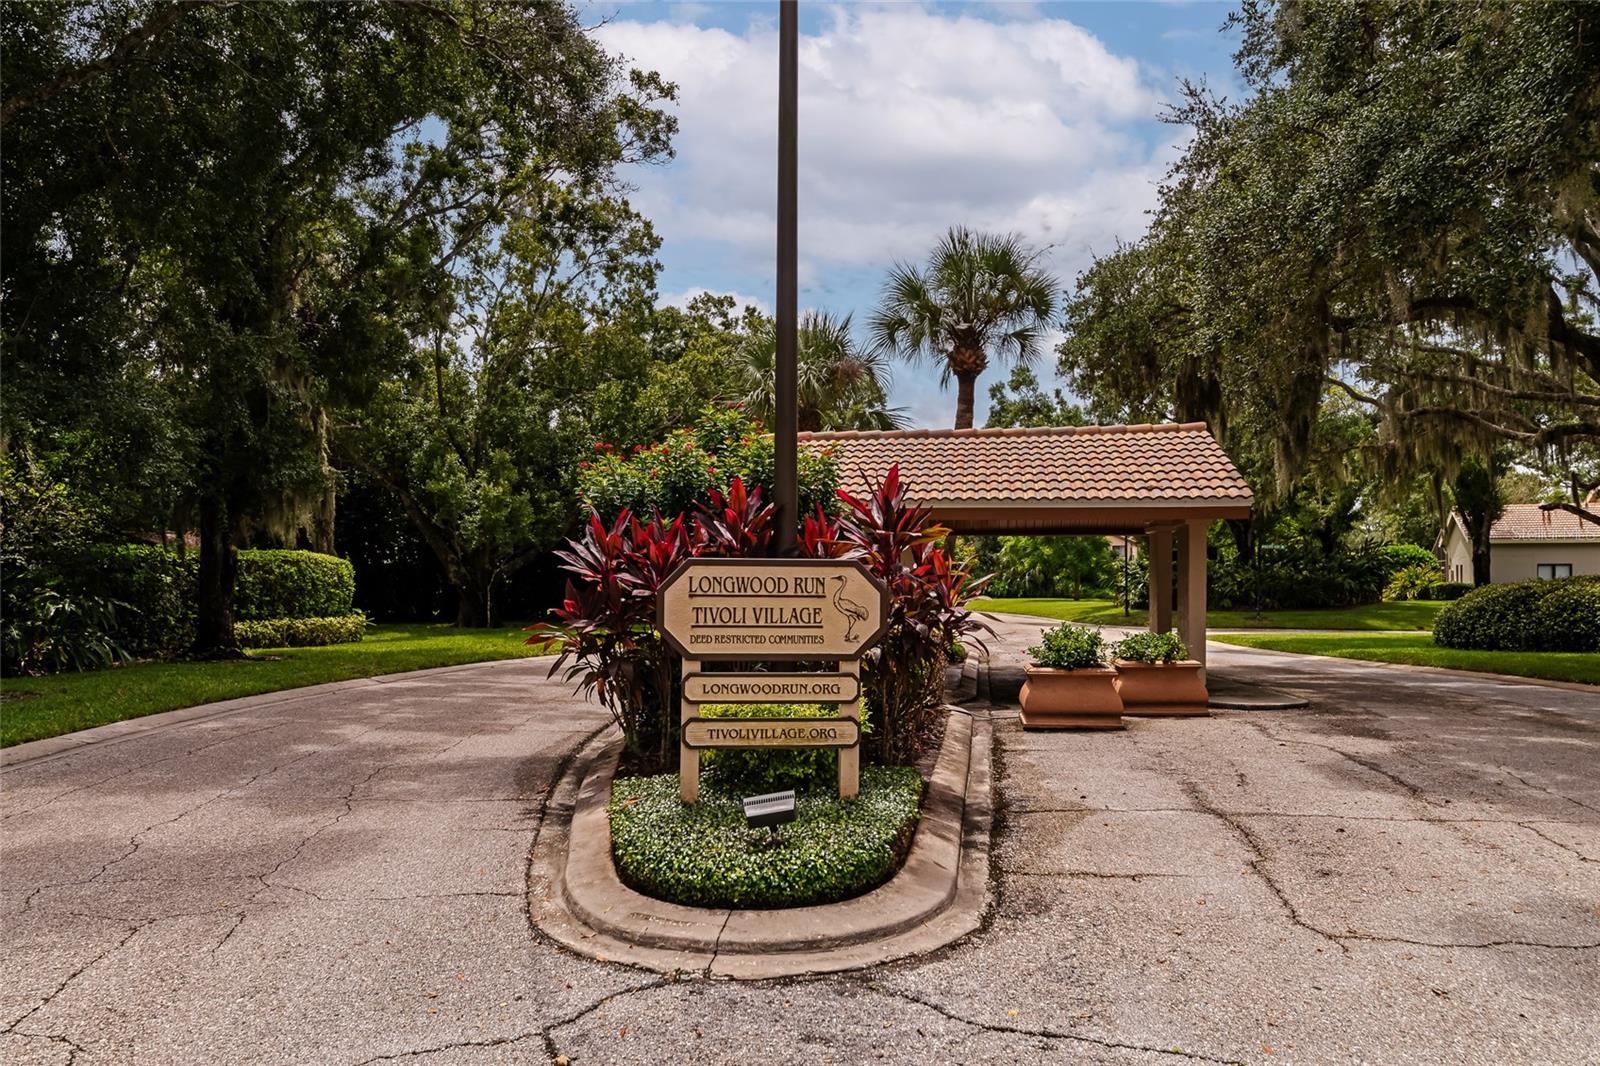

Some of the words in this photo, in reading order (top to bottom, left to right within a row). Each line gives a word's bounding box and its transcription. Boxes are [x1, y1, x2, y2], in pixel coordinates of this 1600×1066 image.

[688, 576, 789, 594] LONGWOOD
[794, 576, 826, 594] RUN
[691, 606, 746, 624] TIVOLI
[752, 607, 823, 624] VILLAGE
[690, 635, 712, 644] DEED
[715, 635, 766, 644] RESTRICTED
[768, 635, 825, 644] COMMUNITIES
[702, 683, 841, 695] LONGWOODRUN.ORG
[707, 728, 837, 739] TIVOLIVILLAGE.ORG
